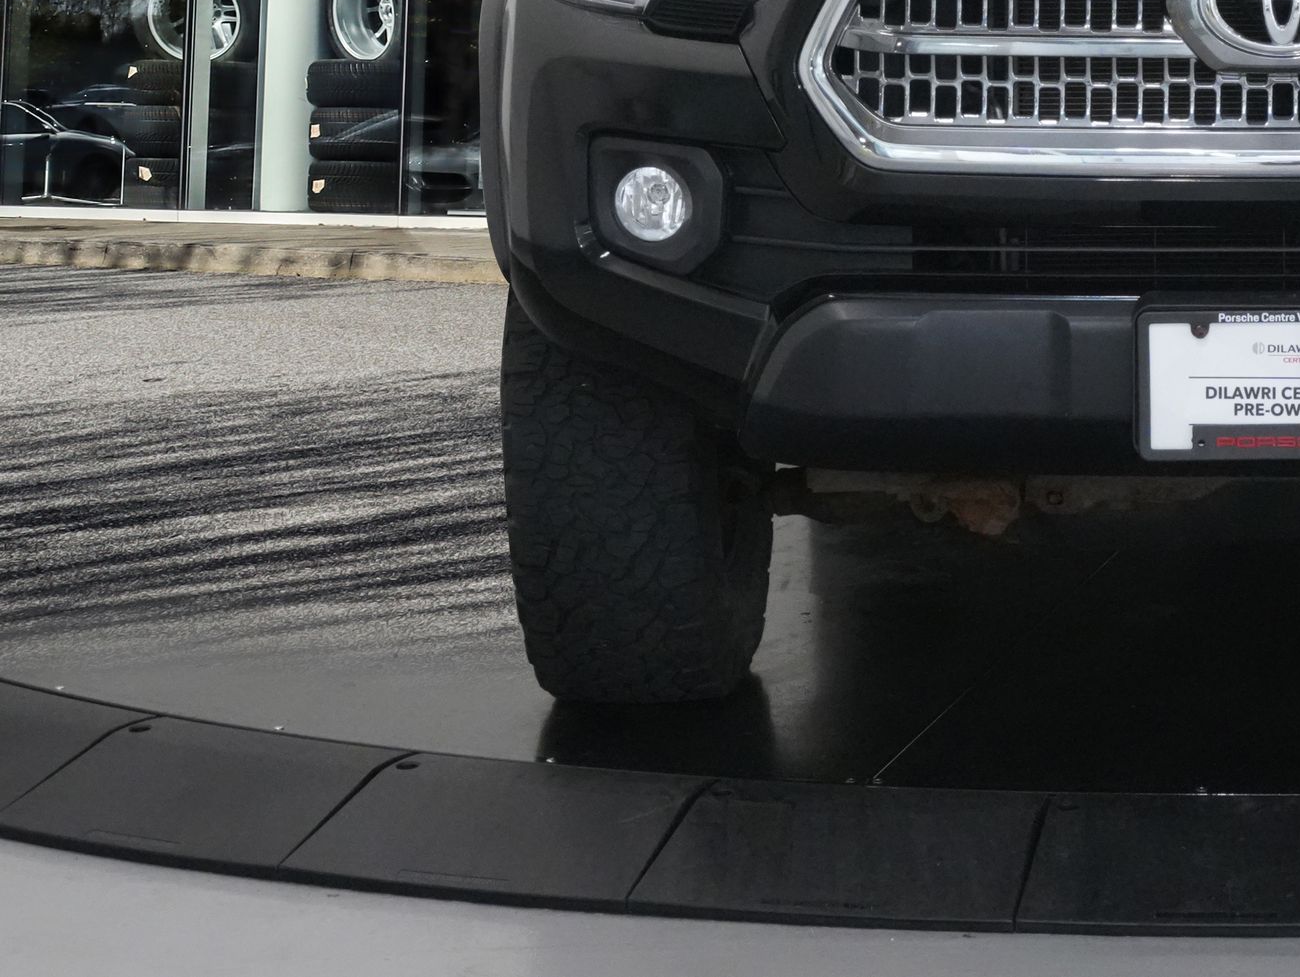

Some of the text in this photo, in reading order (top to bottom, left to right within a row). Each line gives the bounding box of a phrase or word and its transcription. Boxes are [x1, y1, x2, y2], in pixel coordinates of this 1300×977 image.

[1218, 312, 1260, 323] Porsche
[1261, 312, 1296, 322] Centre
[1205, 386, 1276, 399] DILAWRI
